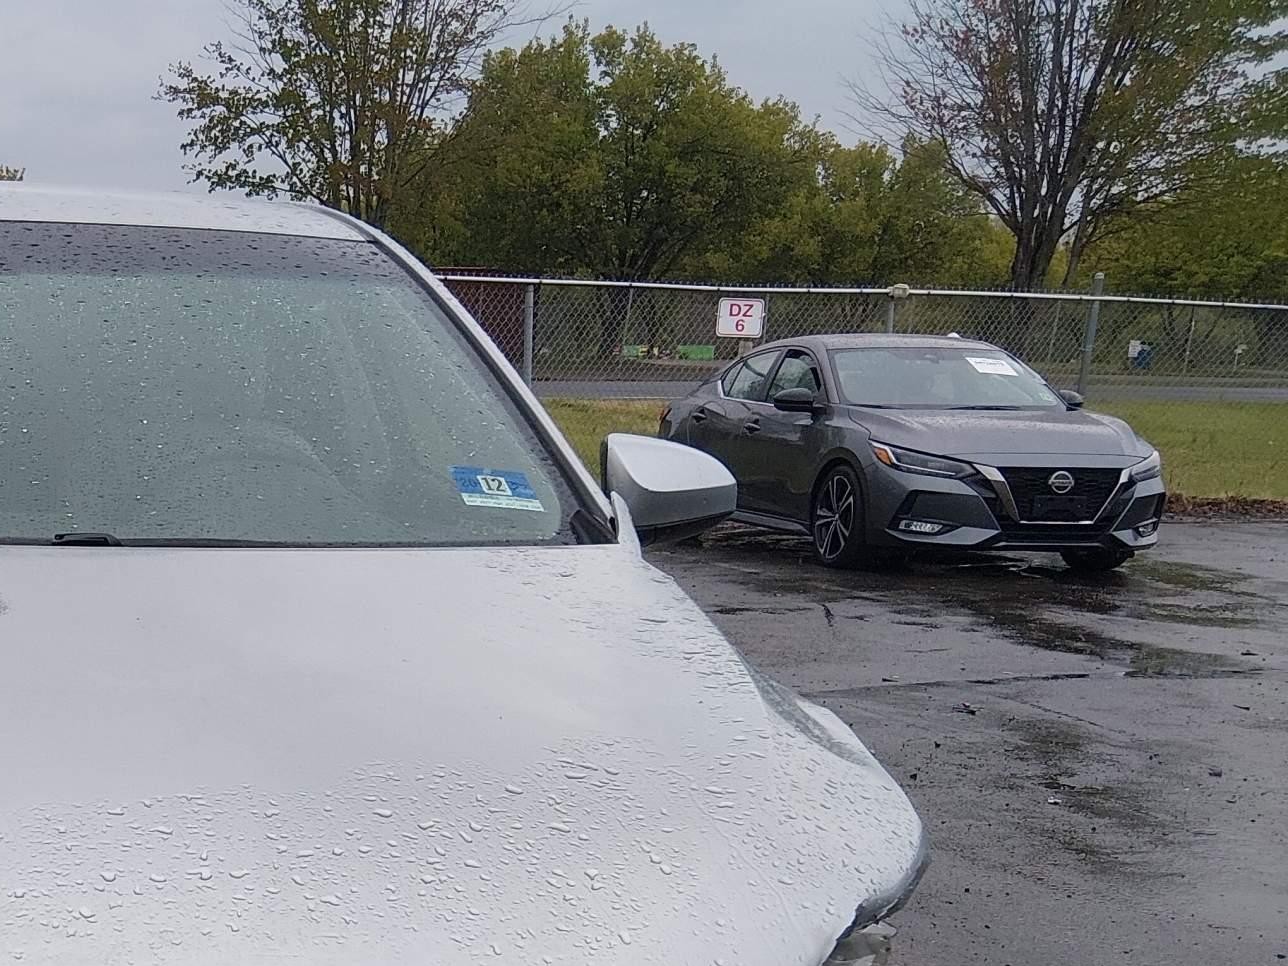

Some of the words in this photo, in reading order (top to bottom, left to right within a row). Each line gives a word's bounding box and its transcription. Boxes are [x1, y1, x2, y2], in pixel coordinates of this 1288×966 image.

[729, 303, 754, 317] DZ
[735, 319, 745, 332] 6
[481, 477, 506, 492] 12
